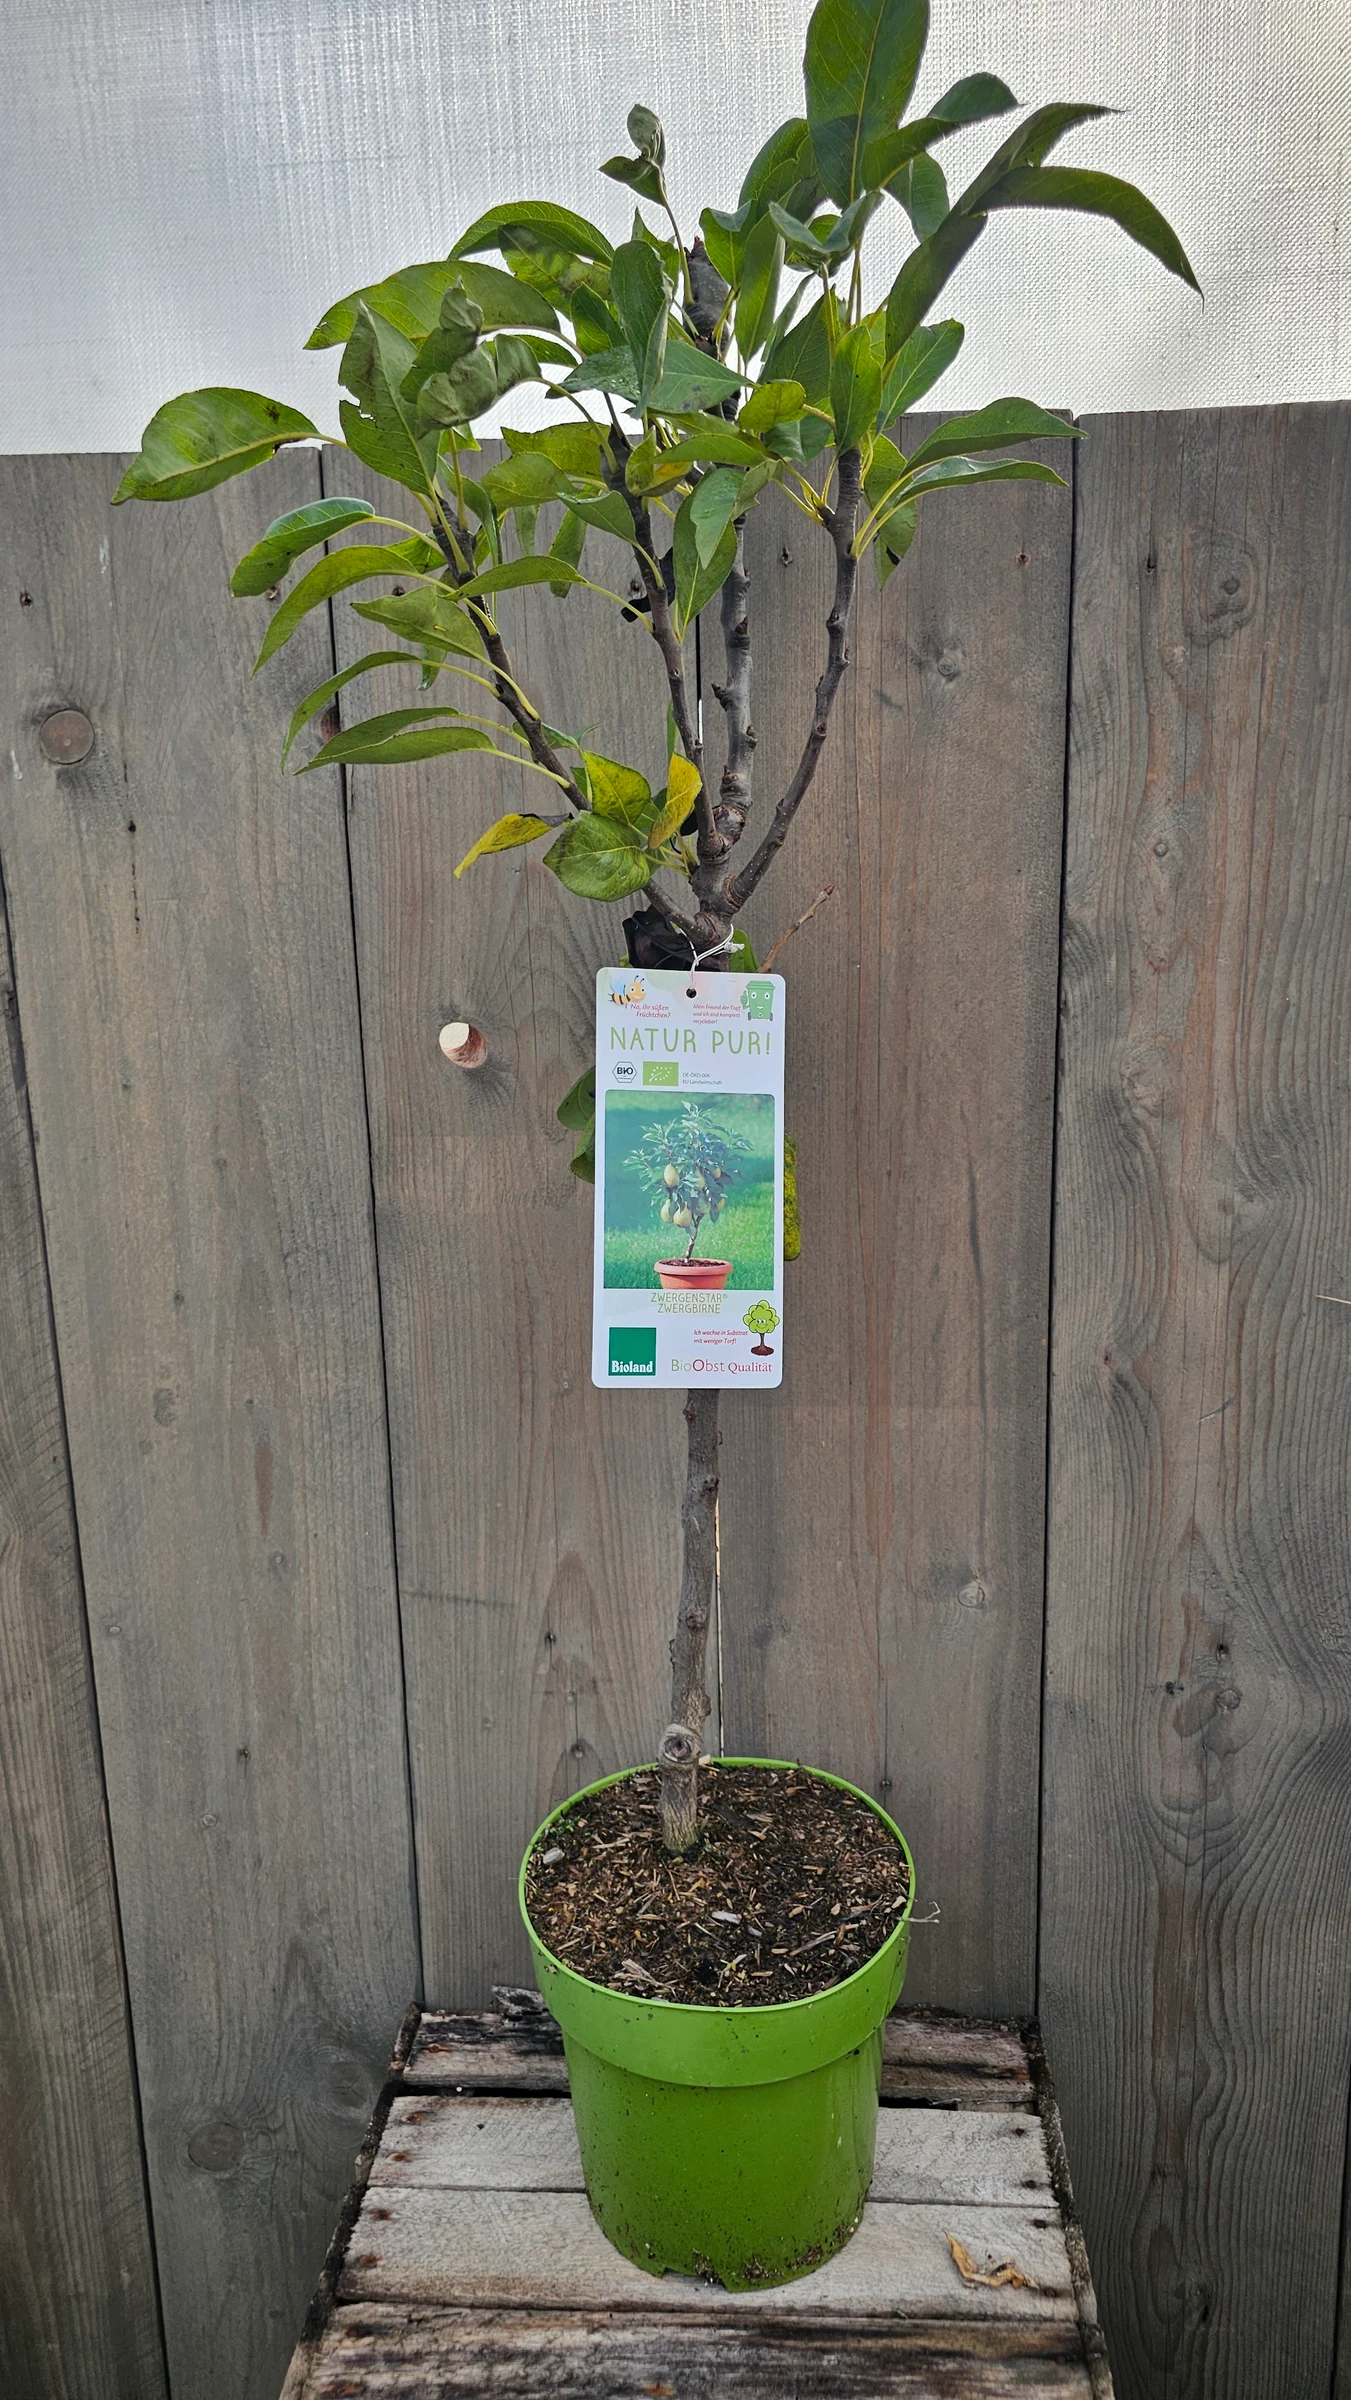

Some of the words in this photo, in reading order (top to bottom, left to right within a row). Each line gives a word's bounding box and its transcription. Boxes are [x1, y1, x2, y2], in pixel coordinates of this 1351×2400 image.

[611, 1027, 697, 1052] NATUR
[712, 1030, 771, 1055] PUR!
[658, 1304, 721, 1314] ZWERGBIRNE
[611, 1360, 653, 1373] Bioland
[728, 1362, 772, 1374] Qualität
